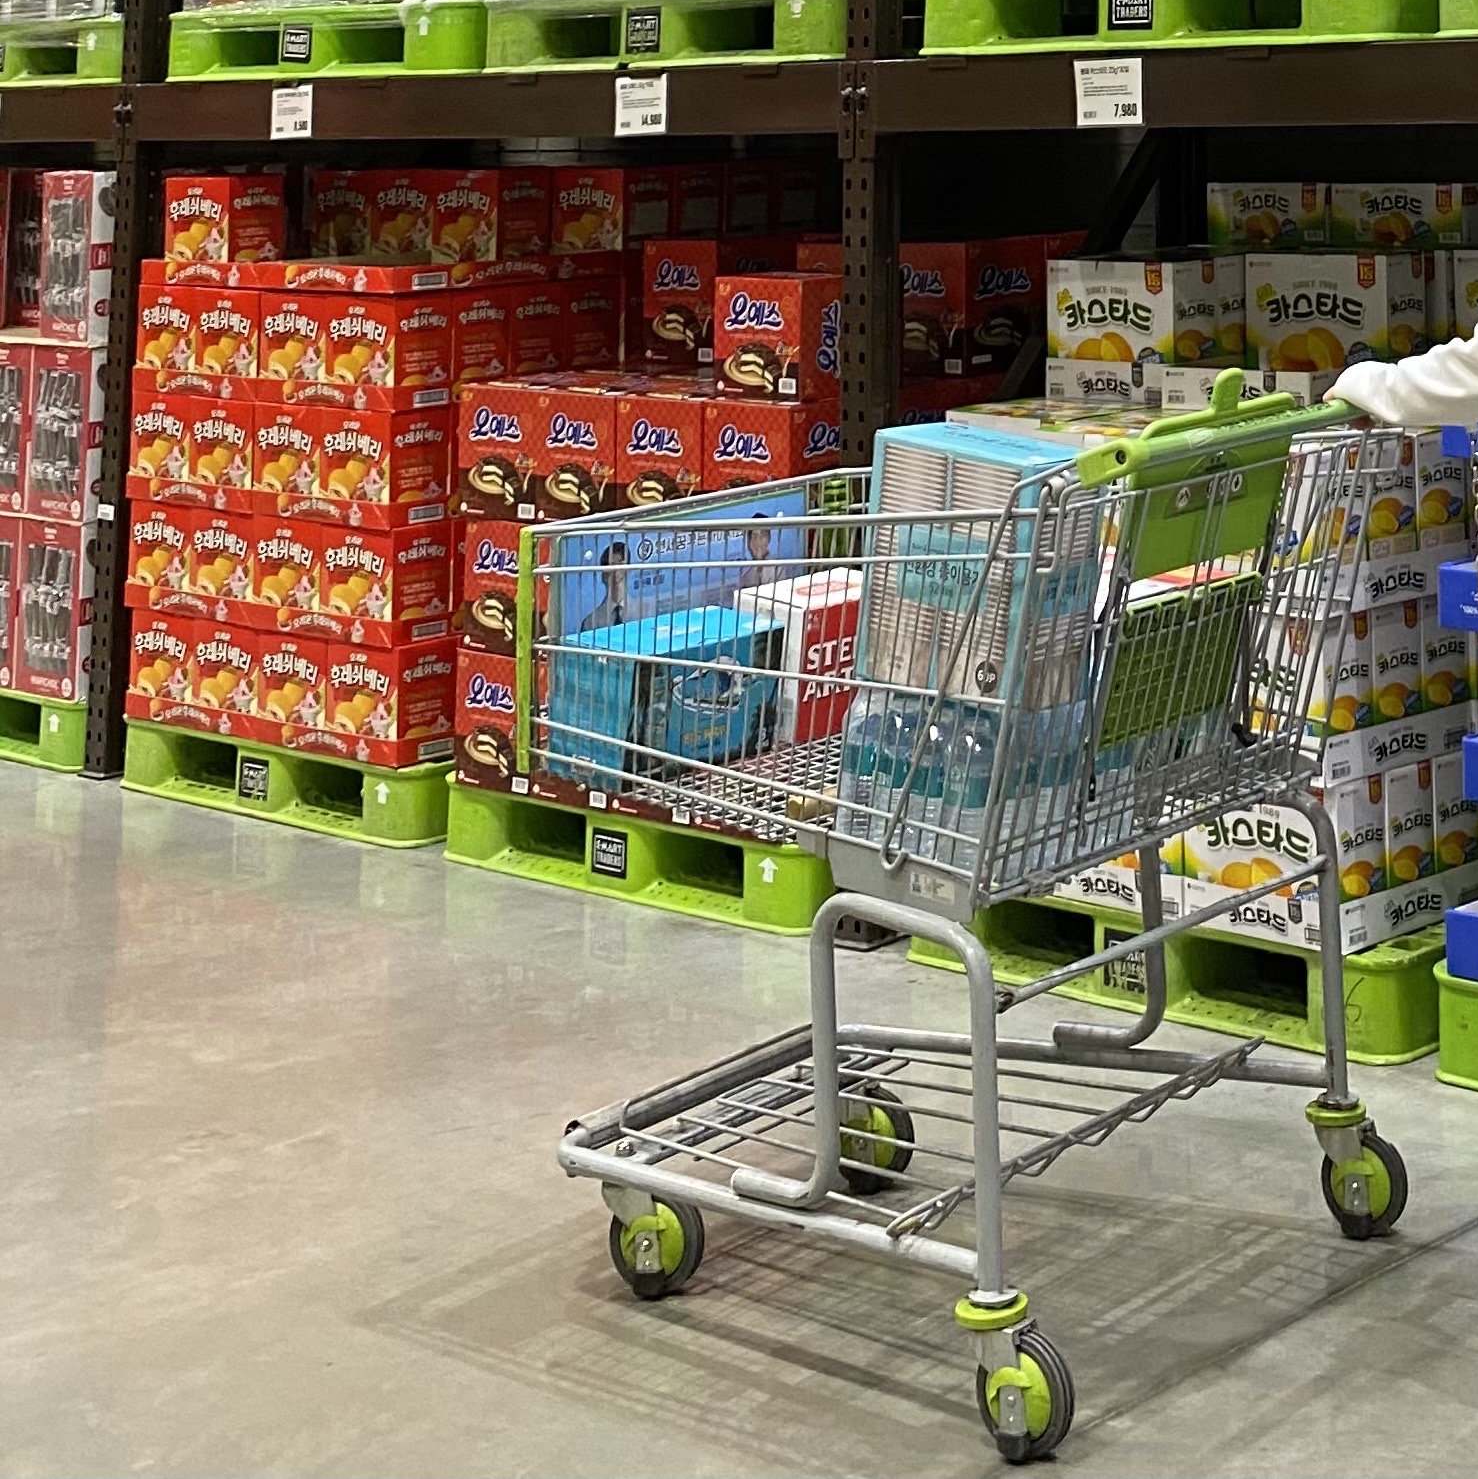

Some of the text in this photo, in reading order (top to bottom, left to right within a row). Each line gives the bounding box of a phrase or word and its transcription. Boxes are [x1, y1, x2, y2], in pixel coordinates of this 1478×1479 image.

[1116, 6, 1148, 18] TRADERS
[1237, 193, 1290, 215] 카스타드
[1365, 193, 1423, 215] 카스타드
[653, 258, 700, 292] 오예스
[264, 310, 319, 340] 후레쉬베리
[725, 291, 784, 330] 오예스
[1064, 295, 1154, 332] 카스타드
[1266, 292, 1364, 327] 카스타드
[329, 315, 388, 345] 후레쉬베리
[1081, 376, 1132, 396] 카스타드
[134, 412, 185, 440] 후레쉬베리
[193, 420, 246, 449] 후레쉬베리
[470, 405, 521, 441] 오예스
[547, 412, 597, 449] 오예스
[627, 418, 683, 457] 오예스
[257, 425, 313, 455] 후레쉬베리
[323, 431, 383, 461] 후레쉬베리
[715, 424, 770, 463] 오예스
[133, 521, 185, 550] 후레쉬베리
[193, 528, 249, 560] 후레쉬베리
[257, 538, 314, 569] 후레쉬베리
[324, 546, 385, 577] 후레쉬베리
[134, 631, 188, 662] 후레쉬베리
[196, 641, 252, 674] 후레쉬베리
[262, 653, 319, 685] 후레쉬베리
[330, 663, 390, 696] 후레쉬베리
[466, 673, 515, 712] 오예스
[1373, 731, 1430, 763] 카스타드
[1206, 817, 1314, 864] 카스타드
[1080, 875, 1136, 905] 카스타드
[1229, 904, 1288, 935] 카스타드
[1390, 892, 1443, 928] 카스타드
